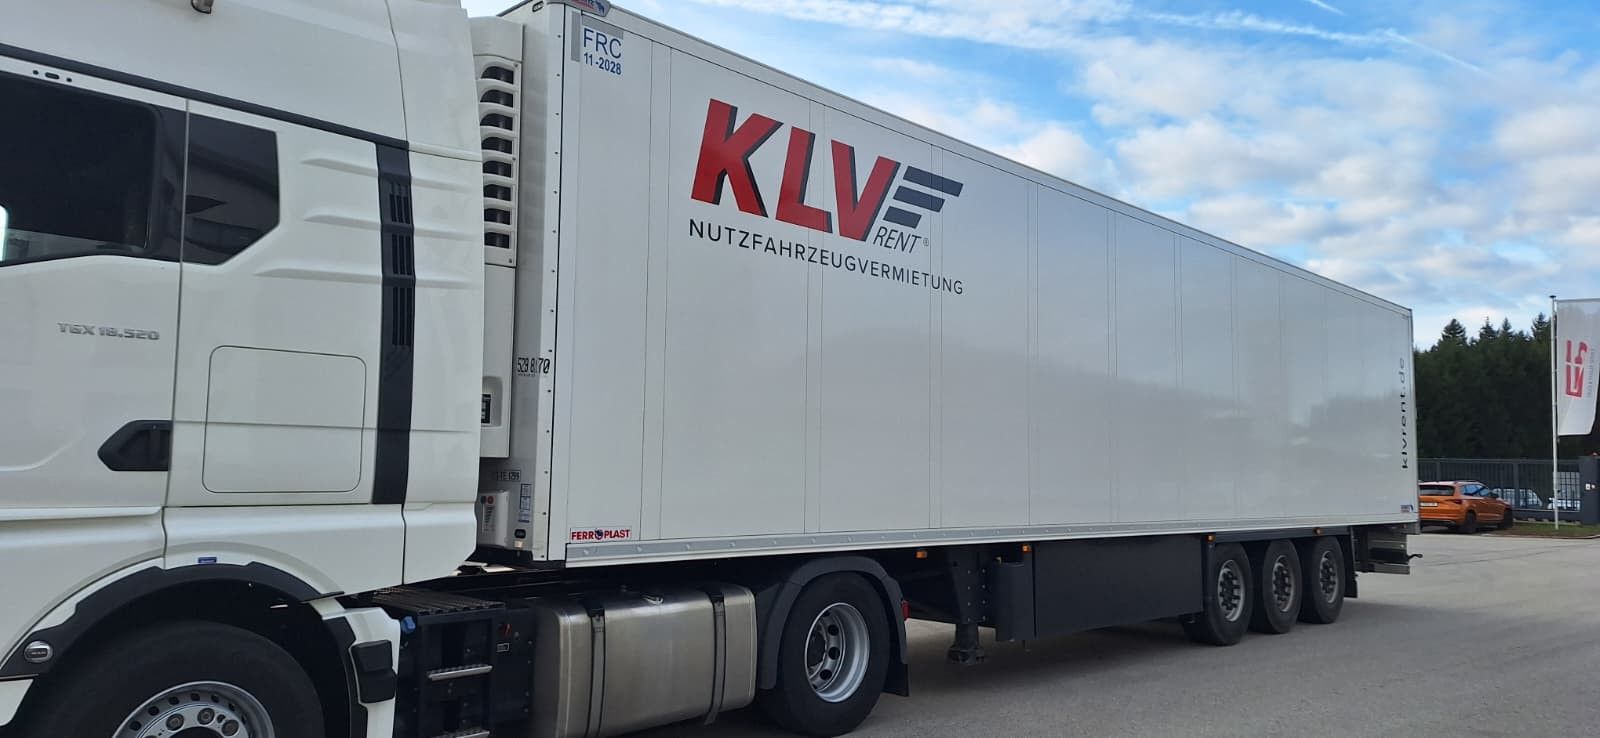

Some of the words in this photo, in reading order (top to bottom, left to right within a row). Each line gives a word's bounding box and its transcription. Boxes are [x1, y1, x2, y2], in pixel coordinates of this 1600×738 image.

[583, 27, 622, 59] FRC
[691, 98, 901, 242] KLV
[689, 218, 964, 295] NUTZFAHRZEUGVERMIETUNG
[57, 322, 96, 335] TGX
[98, 327, 160, 340] 18.520
[1399, 358, 1408, 469] klvrent.de
